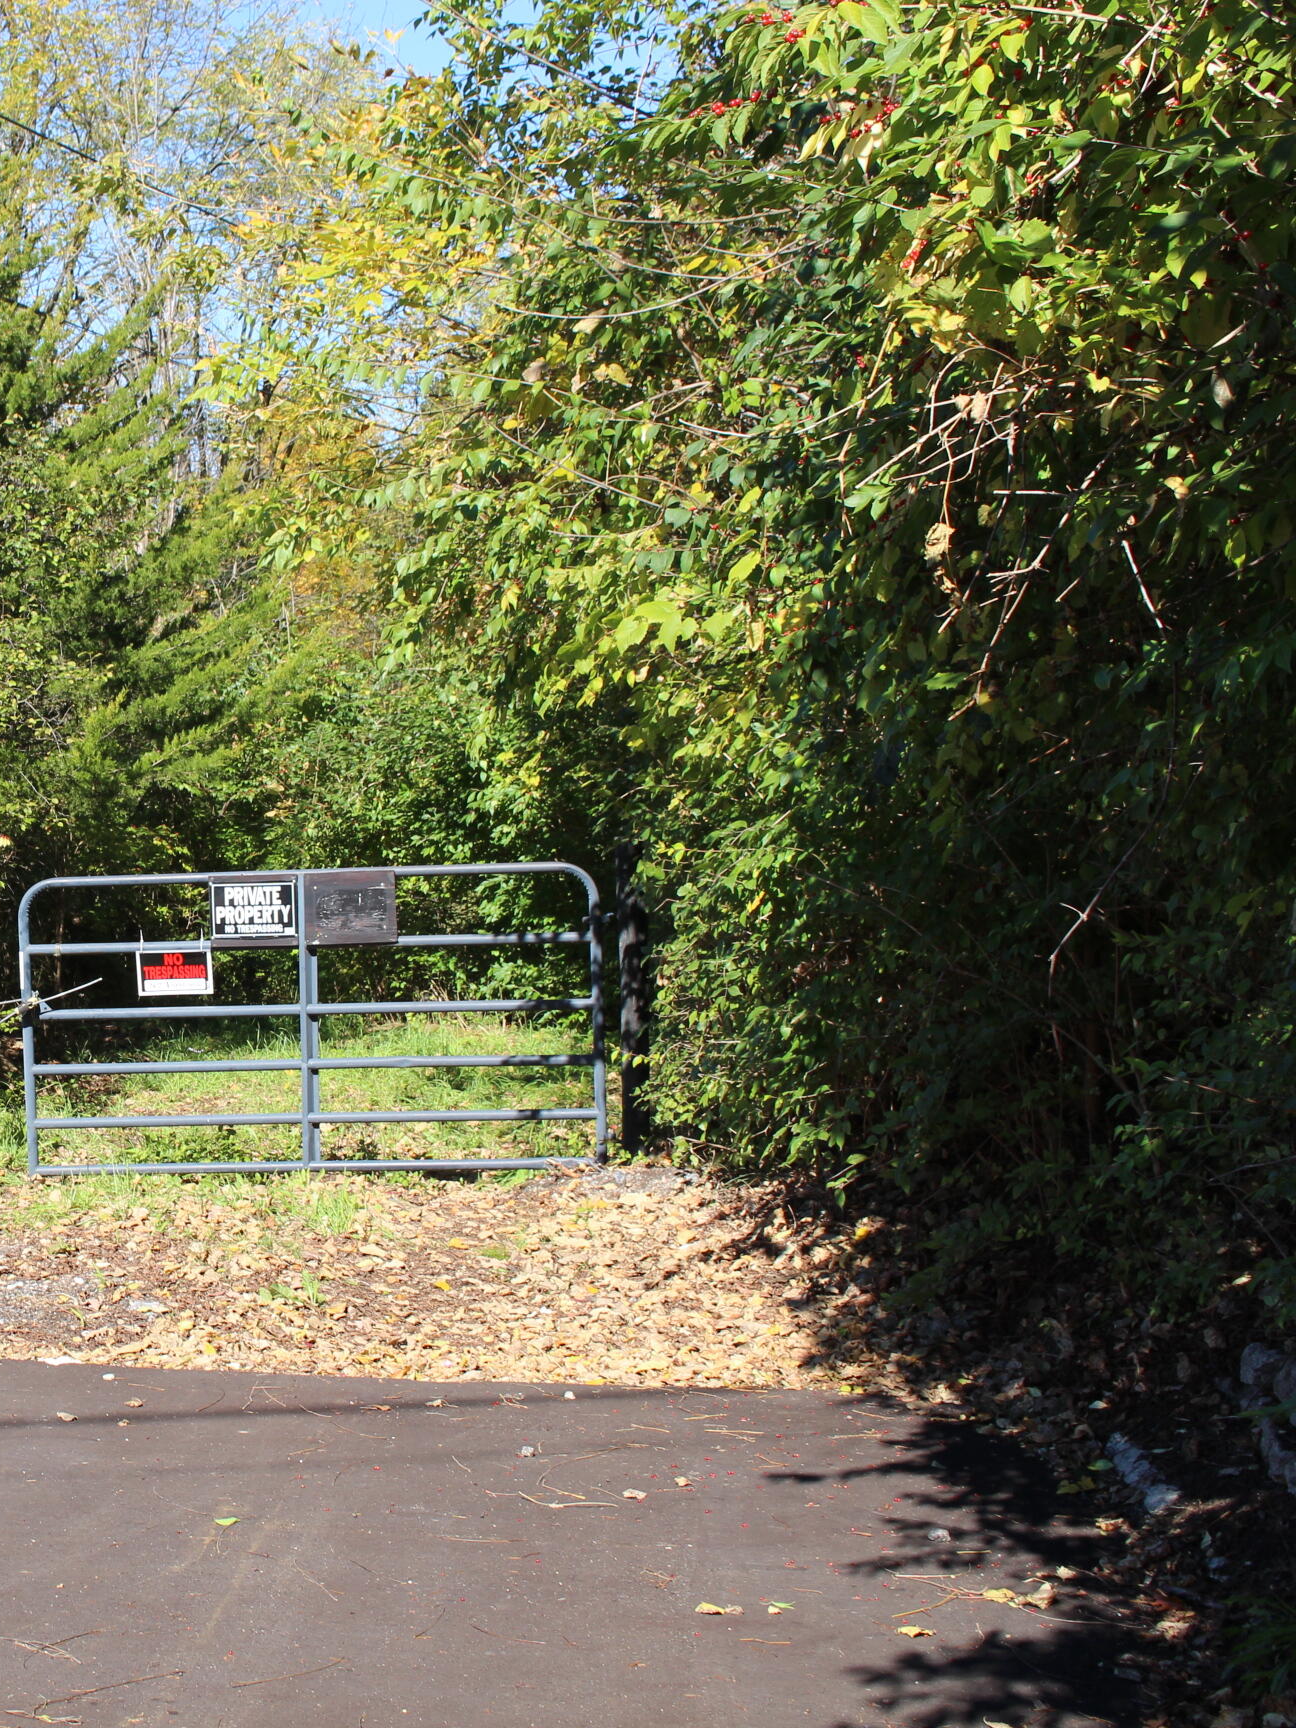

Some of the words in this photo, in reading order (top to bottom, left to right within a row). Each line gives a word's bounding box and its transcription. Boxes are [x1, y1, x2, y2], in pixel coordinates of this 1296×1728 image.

[224, 886, 281, 906] PRIVATE
[215, 905, 291, 924] PROPERTY
[224, 925, 236, 934] NO
[237, 924, 283, 934] TRESPASSING
[164, 953, 183, 965] NO
[143, 965, 206, 980] TRESPASSING
